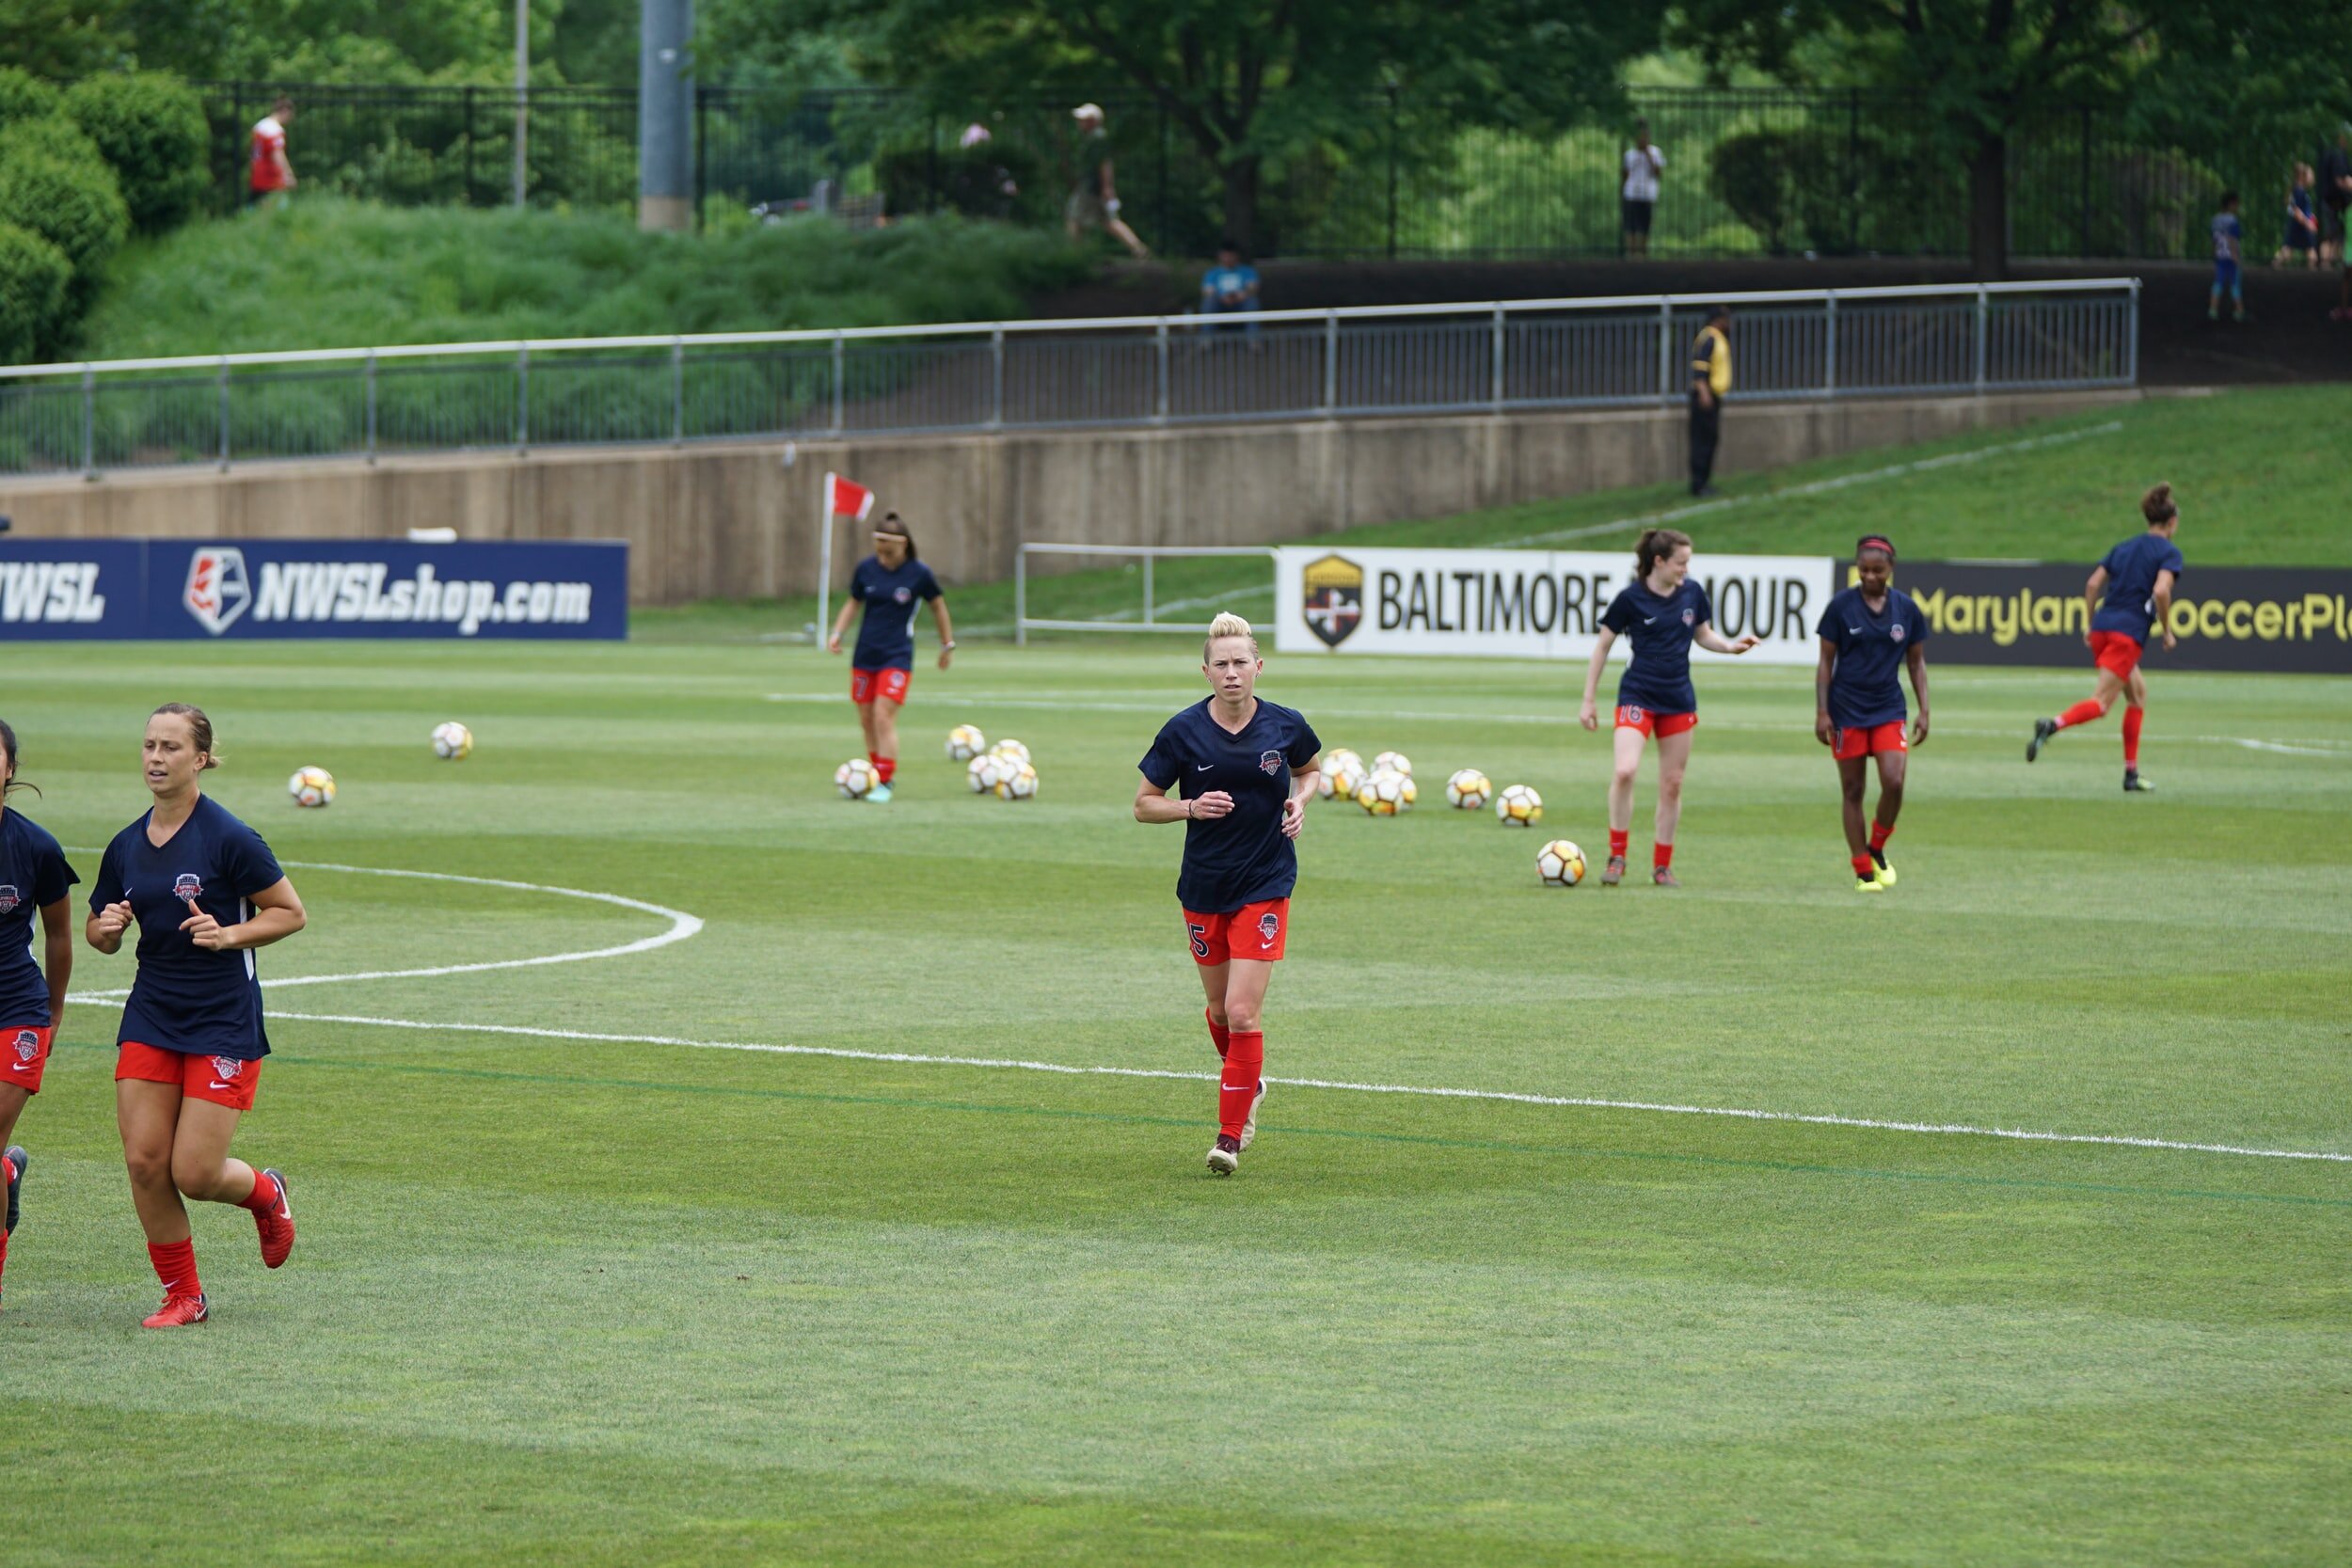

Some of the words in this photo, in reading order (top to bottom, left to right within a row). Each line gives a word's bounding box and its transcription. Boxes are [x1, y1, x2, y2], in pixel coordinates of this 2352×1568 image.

[0, 562, 105, 622] WSL
[253, 562, 592, 635] NWSLshop.com
[1379, 570, 1611, 635] BALTIMORE
[1911, 587, 2104, 646] Marylan
[2148, 592, 2352, 641] occerPl
[1619, 705, 1643, 723] 16
